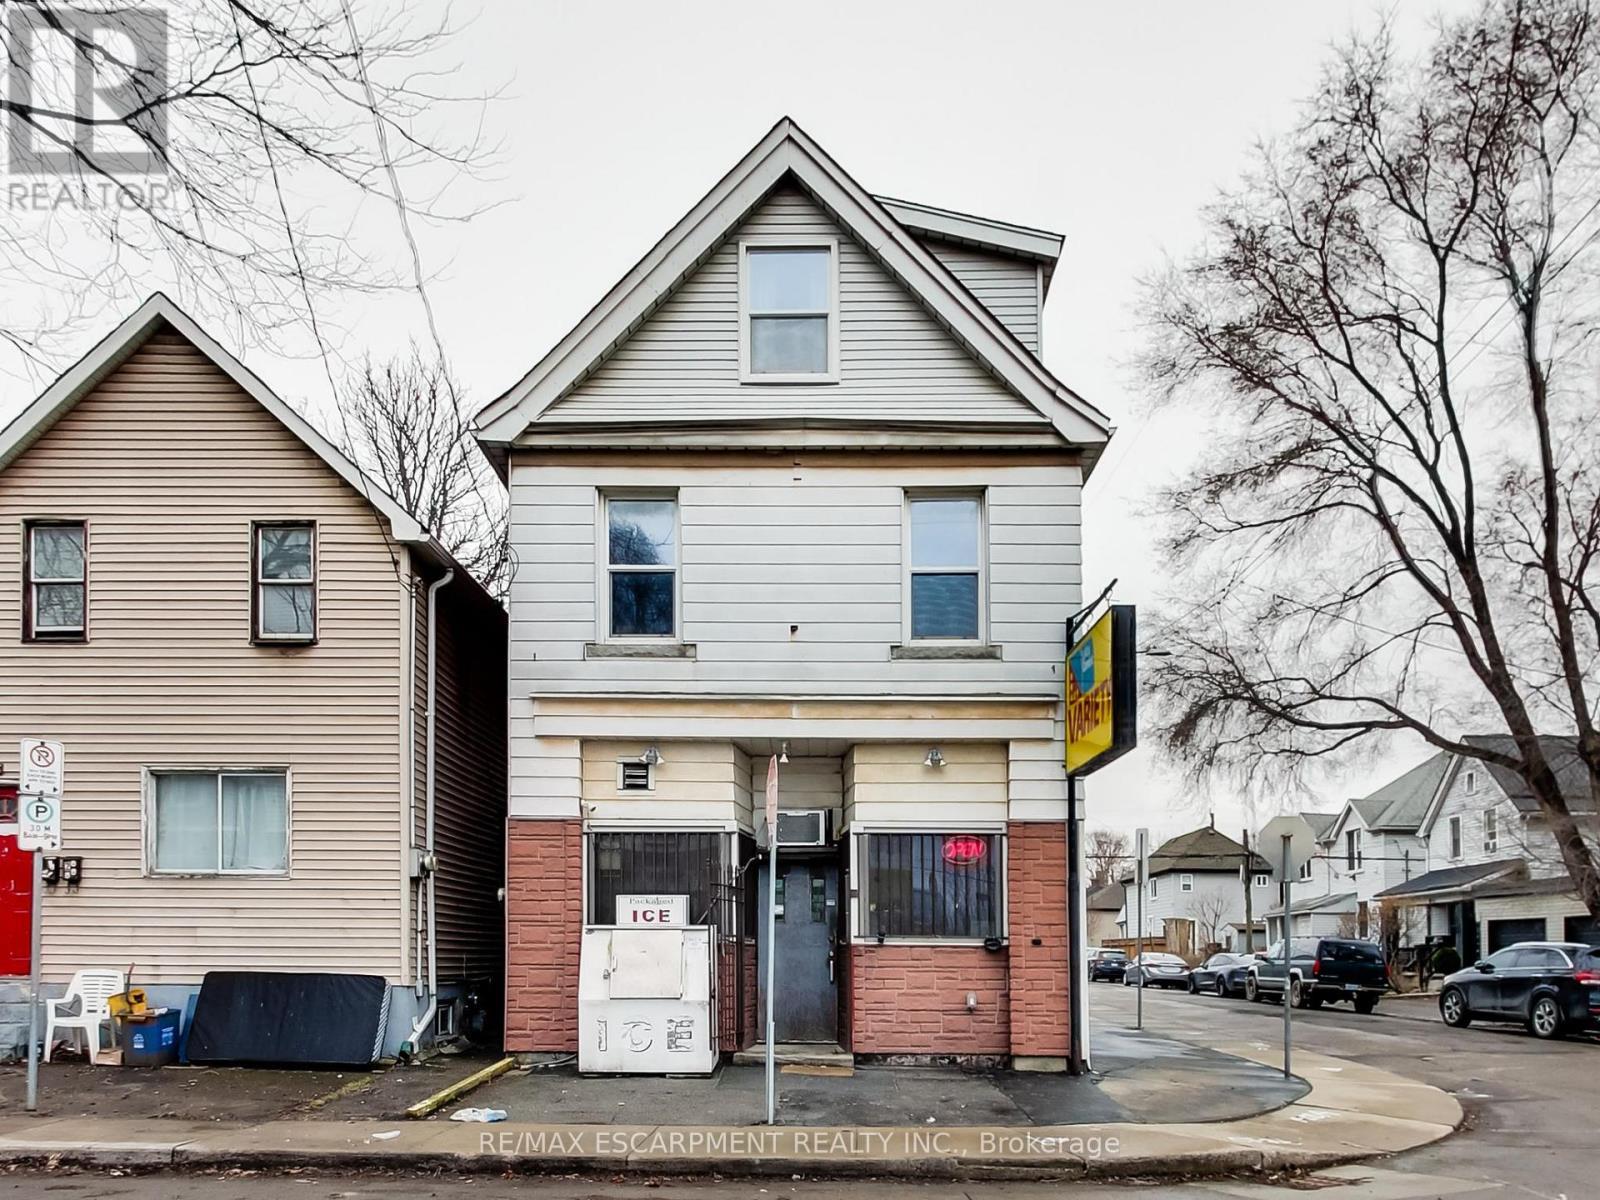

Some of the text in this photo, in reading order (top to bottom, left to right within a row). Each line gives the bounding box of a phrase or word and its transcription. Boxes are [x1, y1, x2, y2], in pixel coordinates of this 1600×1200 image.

[36, 805, 48, 817] P
[945, 842, 984, 858] OPEN
[632, 909, 670, 922] ICE
